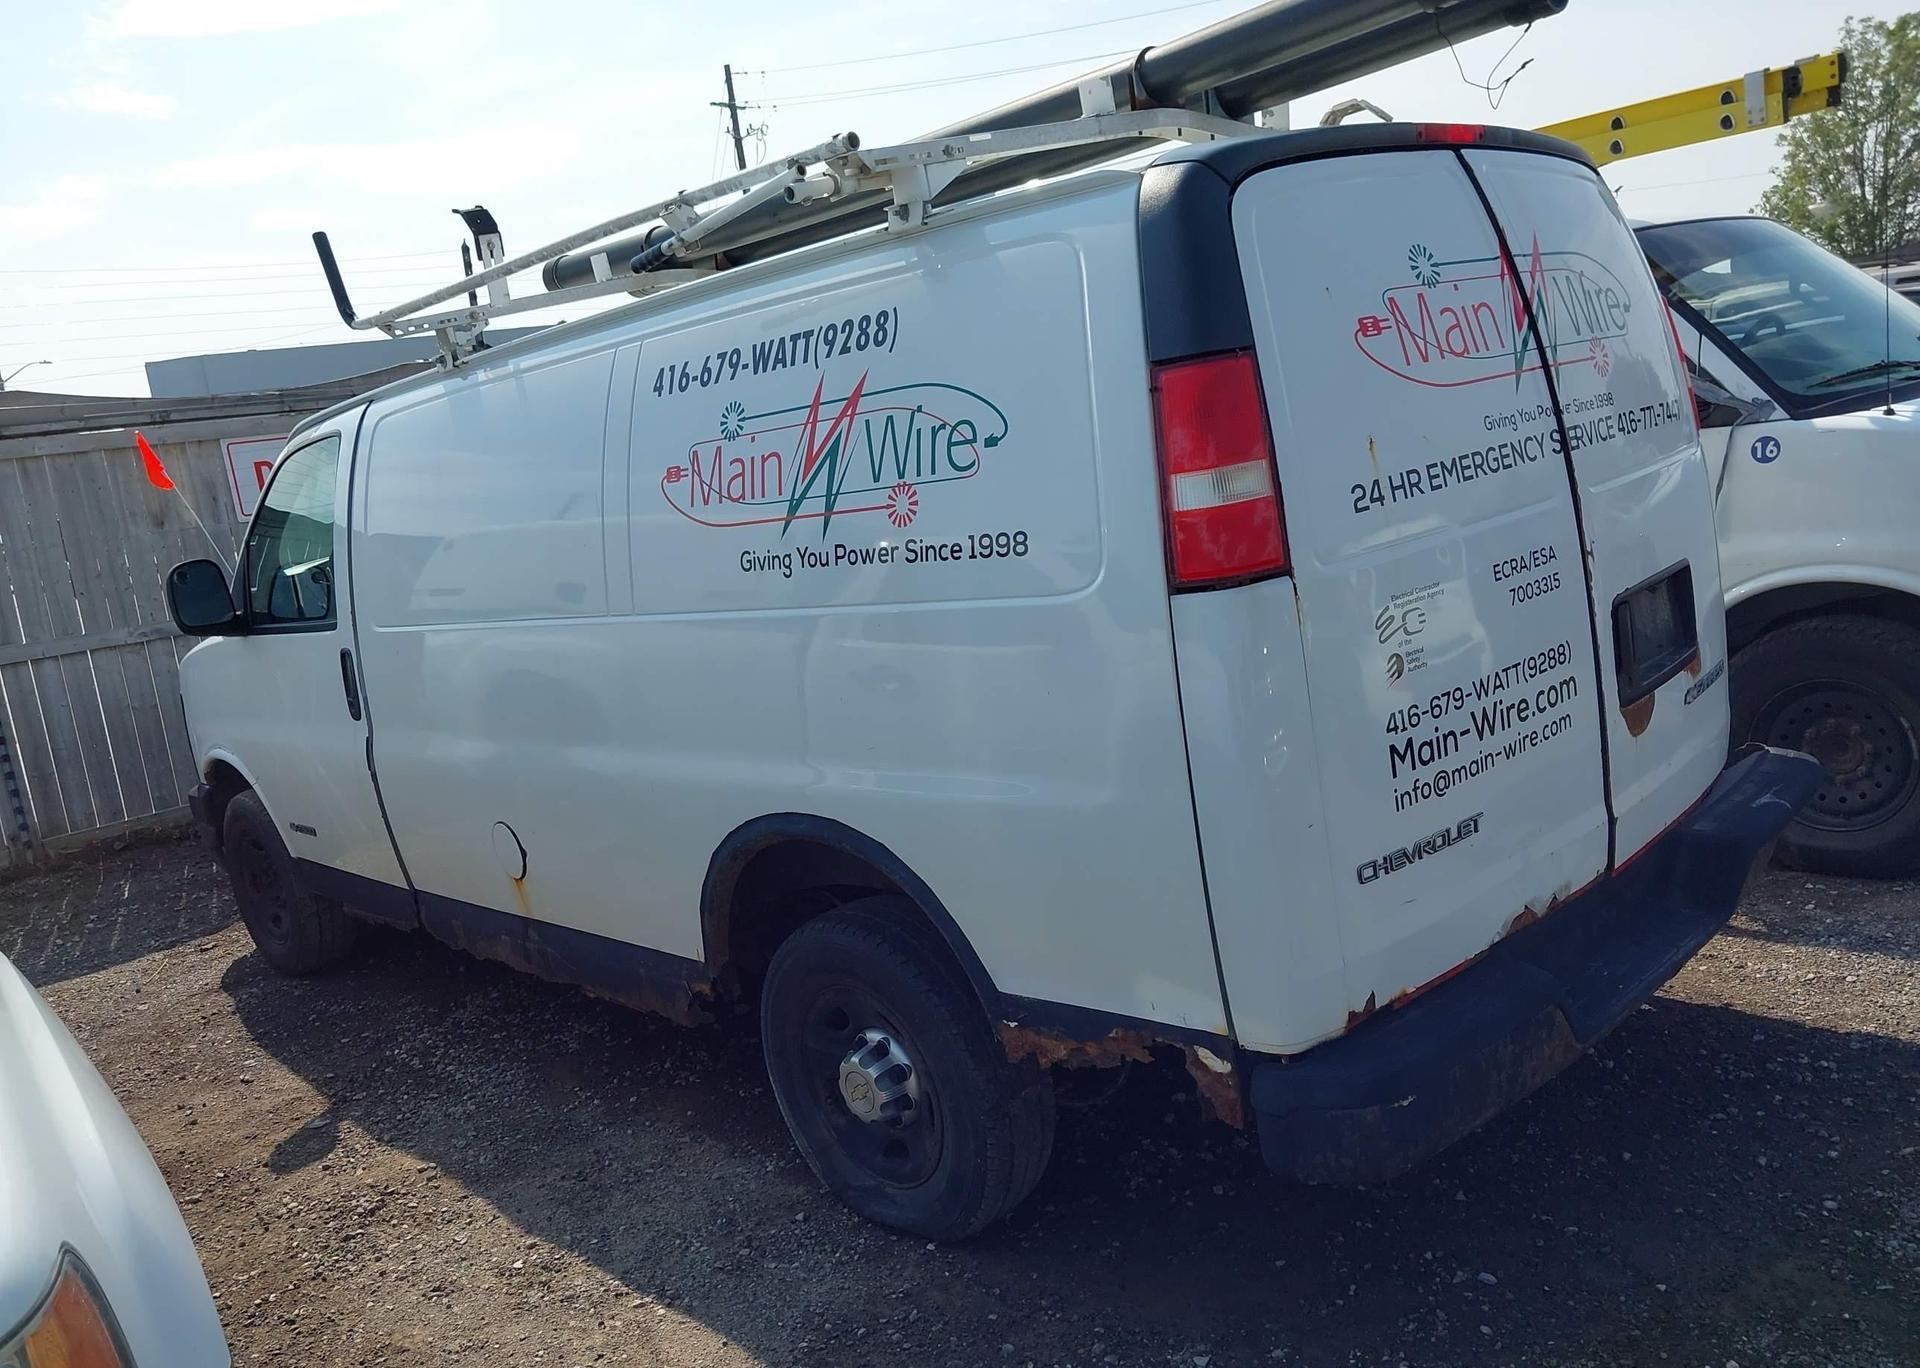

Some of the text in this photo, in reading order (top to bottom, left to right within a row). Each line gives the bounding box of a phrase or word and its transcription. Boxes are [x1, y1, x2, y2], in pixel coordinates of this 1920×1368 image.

[652, 306, 899, 398] 416-679-WATT(9288)
[1388, 270, 1627, 366] Main Wire
[1484, 412, 1518, 432] Giving
[1517, 407, 1537, 423] You
[1573, 397, 1596, 414] Since
[1595, 391, 1616, 410] 1998
[1754, 440, 1778, 459] 16
[689, 404, 978, 508] Main Wire
[1350, 479, 1386, 514] 24
[1389, 468, 1425, 503] HR
[1425, 432, 1546, 492] EMERGENCY
[1549, 415, 1616, 455] SERVICE
[740, 530, 1029, 579] Giving You Power Since 1998
[1390, 588, 1414, 601] Electrical
[1492, 545, 1557, 582] ECRA/ESA
[1509, 572, 1561, 606] 7003315
[1385, 640, 1572, 736] 416-679-WATT(9288)
[1388, 674, 1578, 779] Main-Wire.com
[1394, 712, 1573, 812] info@main-wire.com
[1357, 811, 1484, 884] CHEVROLET
